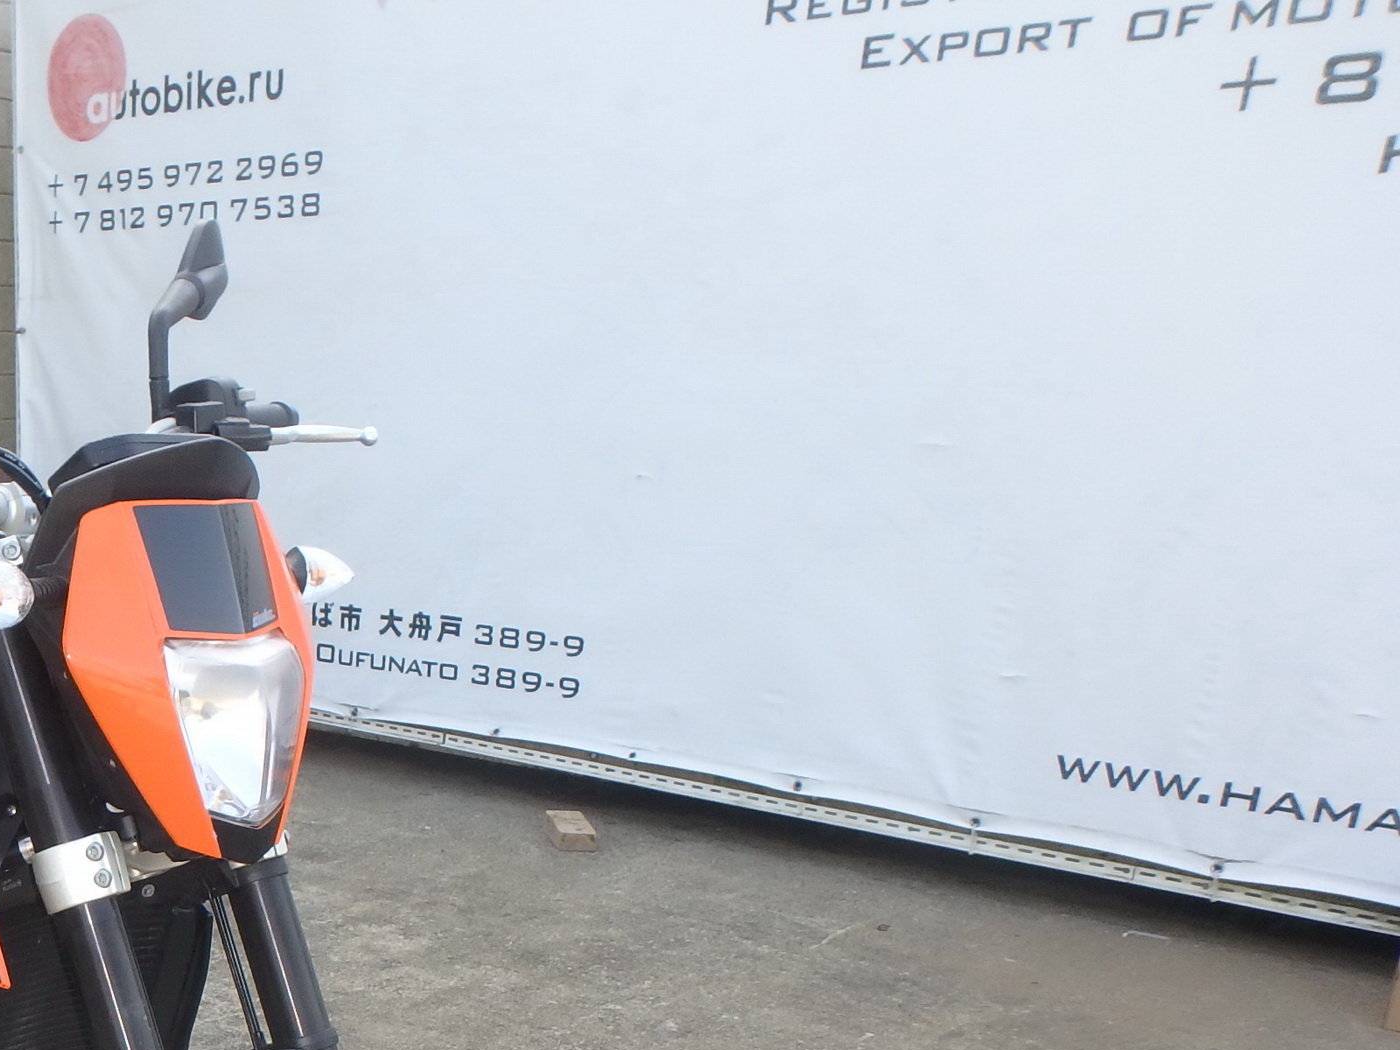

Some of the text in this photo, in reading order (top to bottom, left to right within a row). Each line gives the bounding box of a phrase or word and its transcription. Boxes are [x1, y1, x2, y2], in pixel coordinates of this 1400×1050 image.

[860, 17, 1092, 70] EXPORT
[1126, 3, 1214, 42] OF
[86, 68, 284, 124] autobike.ru
[98, 167, 153, 193] 495
[164, 160, 223, 188] 972
[236, 150, 324, 181] 2969
[100, 206, 145, 230] 812
[157, 201, 217, 227] 970
[230, 192, 321, 222] 7538
[379, 608, 463, 643] 大舟戸
[474, 624, 584, 657] 389-9
[471, 664, 580, 699] 389-9
